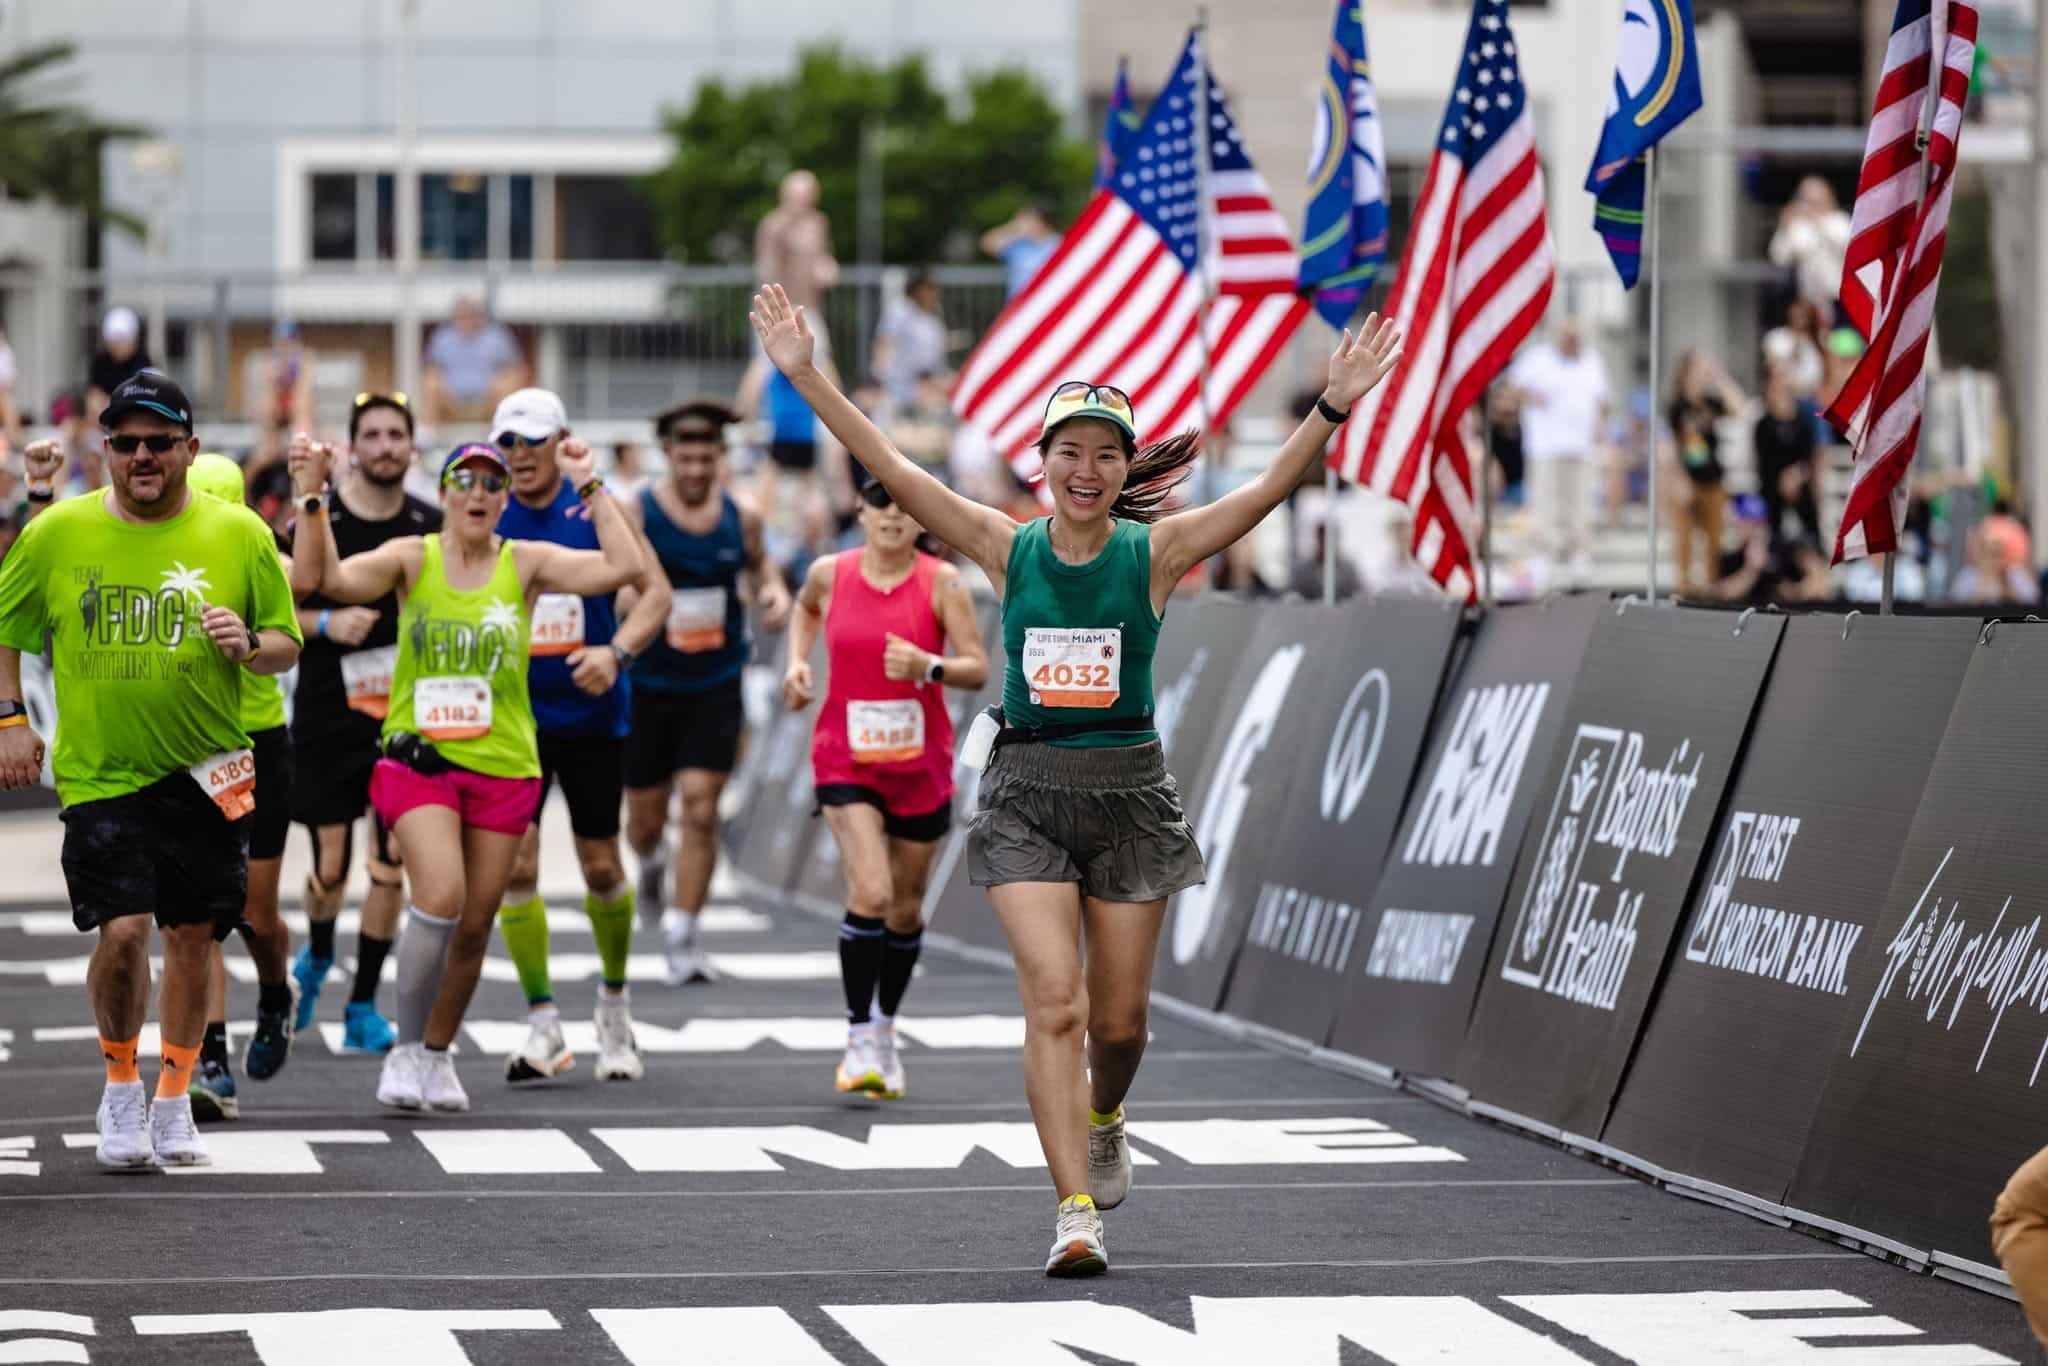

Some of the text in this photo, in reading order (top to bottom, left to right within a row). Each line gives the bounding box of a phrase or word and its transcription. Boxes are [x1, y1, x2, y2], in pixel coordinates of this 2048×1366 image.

[98, 585, 185, 647] FDC
[1072, 633, 1106, 644] MIAMI
[79, 652, 150, 681] WITHIN
[1032, 664, 1110, 687] 4032
[426, 705, 479, 722] 4182
[1402, 683, 1551, 866] HOKA
[1594, 732, 1704, 882] Baptist
[1740, 814, 1801, 882] FIRST
[1545, 882, 1645, 1010] Health
[1710, 902, 1802, 980] HORIZON
